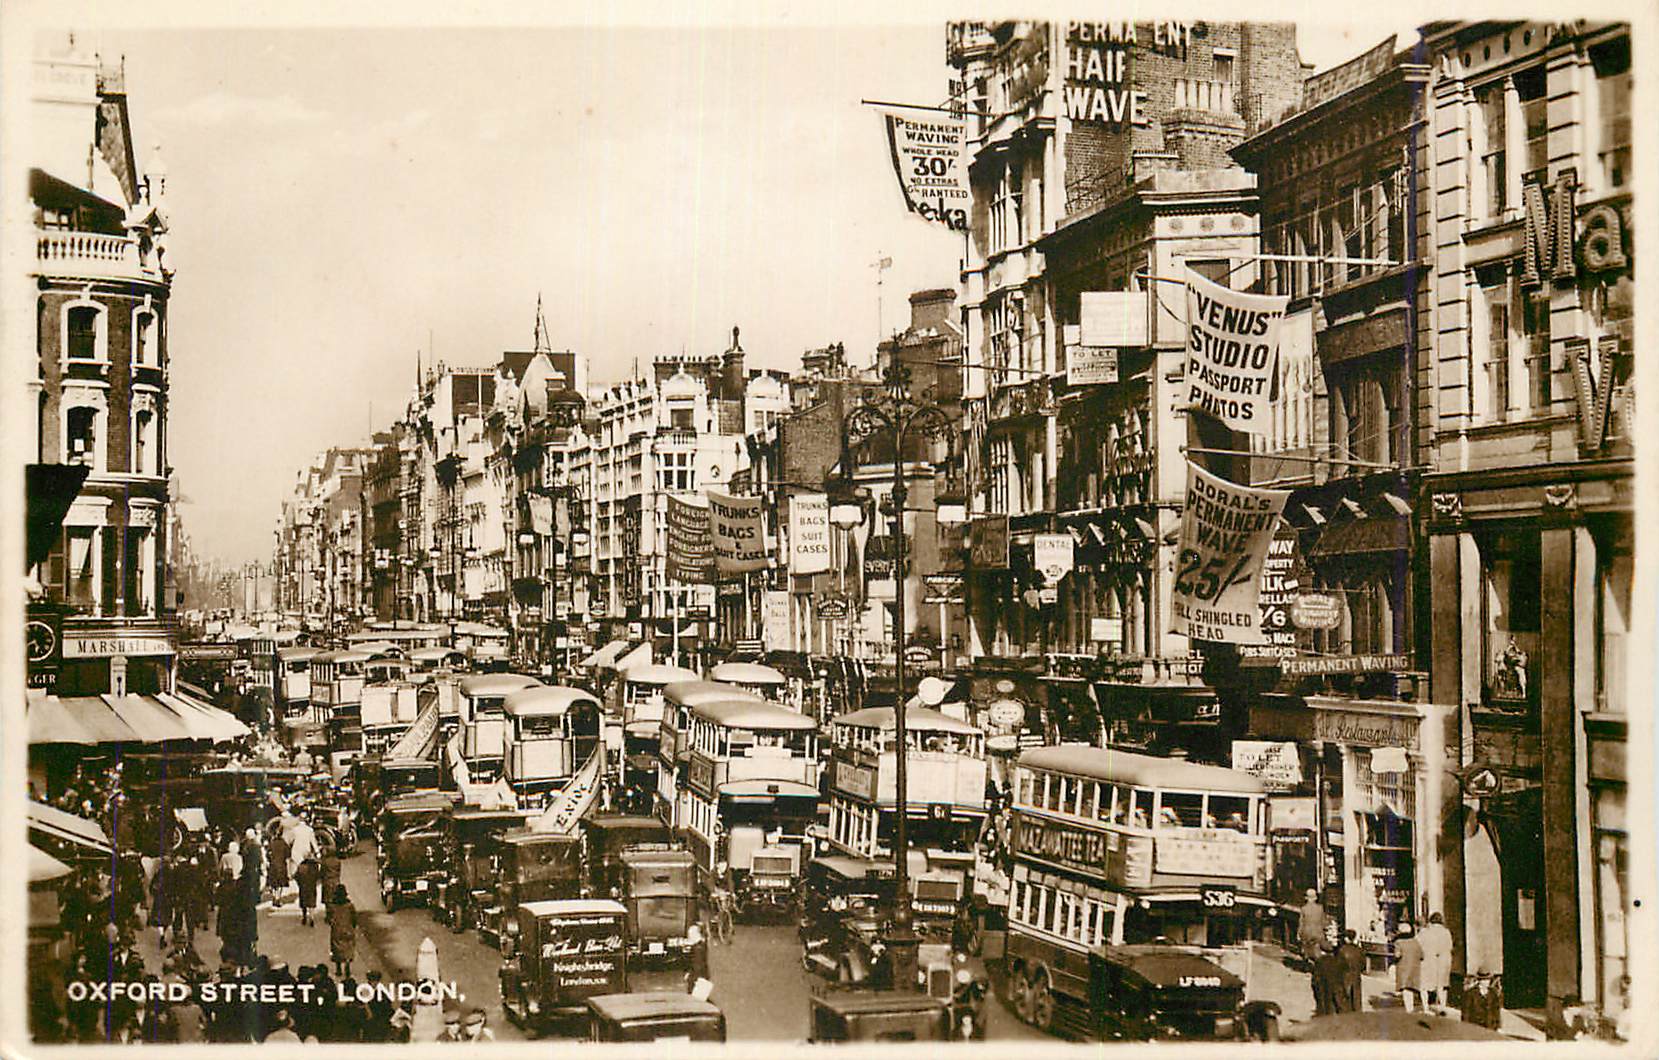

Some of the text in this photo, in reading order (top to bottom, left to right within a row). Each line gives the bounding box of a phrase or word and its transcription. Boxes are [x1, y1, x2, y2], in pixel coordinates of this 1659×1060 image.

[895, 118, 964, 134] PERMANENT
[906, 131, 959, 144] WAVING
[902, 147, 959, 157] WHOLE HEAD
[925, 177, 958, 185] EXTRAS
[1187, 282, 1282, 336] "VENUS"
[1191, 324, 1269, 369] STUDIO
[1190, 358, 1267, 395] PASSPORT
[1189, 385, 1254, 420] PHOTOS
[1195, 474, 1271, 510] DORAL'S
[711, 500, 760, 519] TRUNKS
[796, 501, 828, 510] TRUNKS
[1186, 488, 1278, 531] PERMANENT
[801, 516, 826, 526] BAGS
[719, 523, 754, 540] BAGS
[802, 532, 824, 540] SUIT
[1198, 522, 1249, 553] WAVE
[625, 517, 635, 598] DOLCIS
[797, 546, 828, 554] CASES
[1195, 608, 1253, 629] SHINGLED
[1188, 622, 1224, 640] HEAD
[77, 640, 147, 654] MARSHALL
[1282, 654, 1409, 674] PERMANENT WAVING
